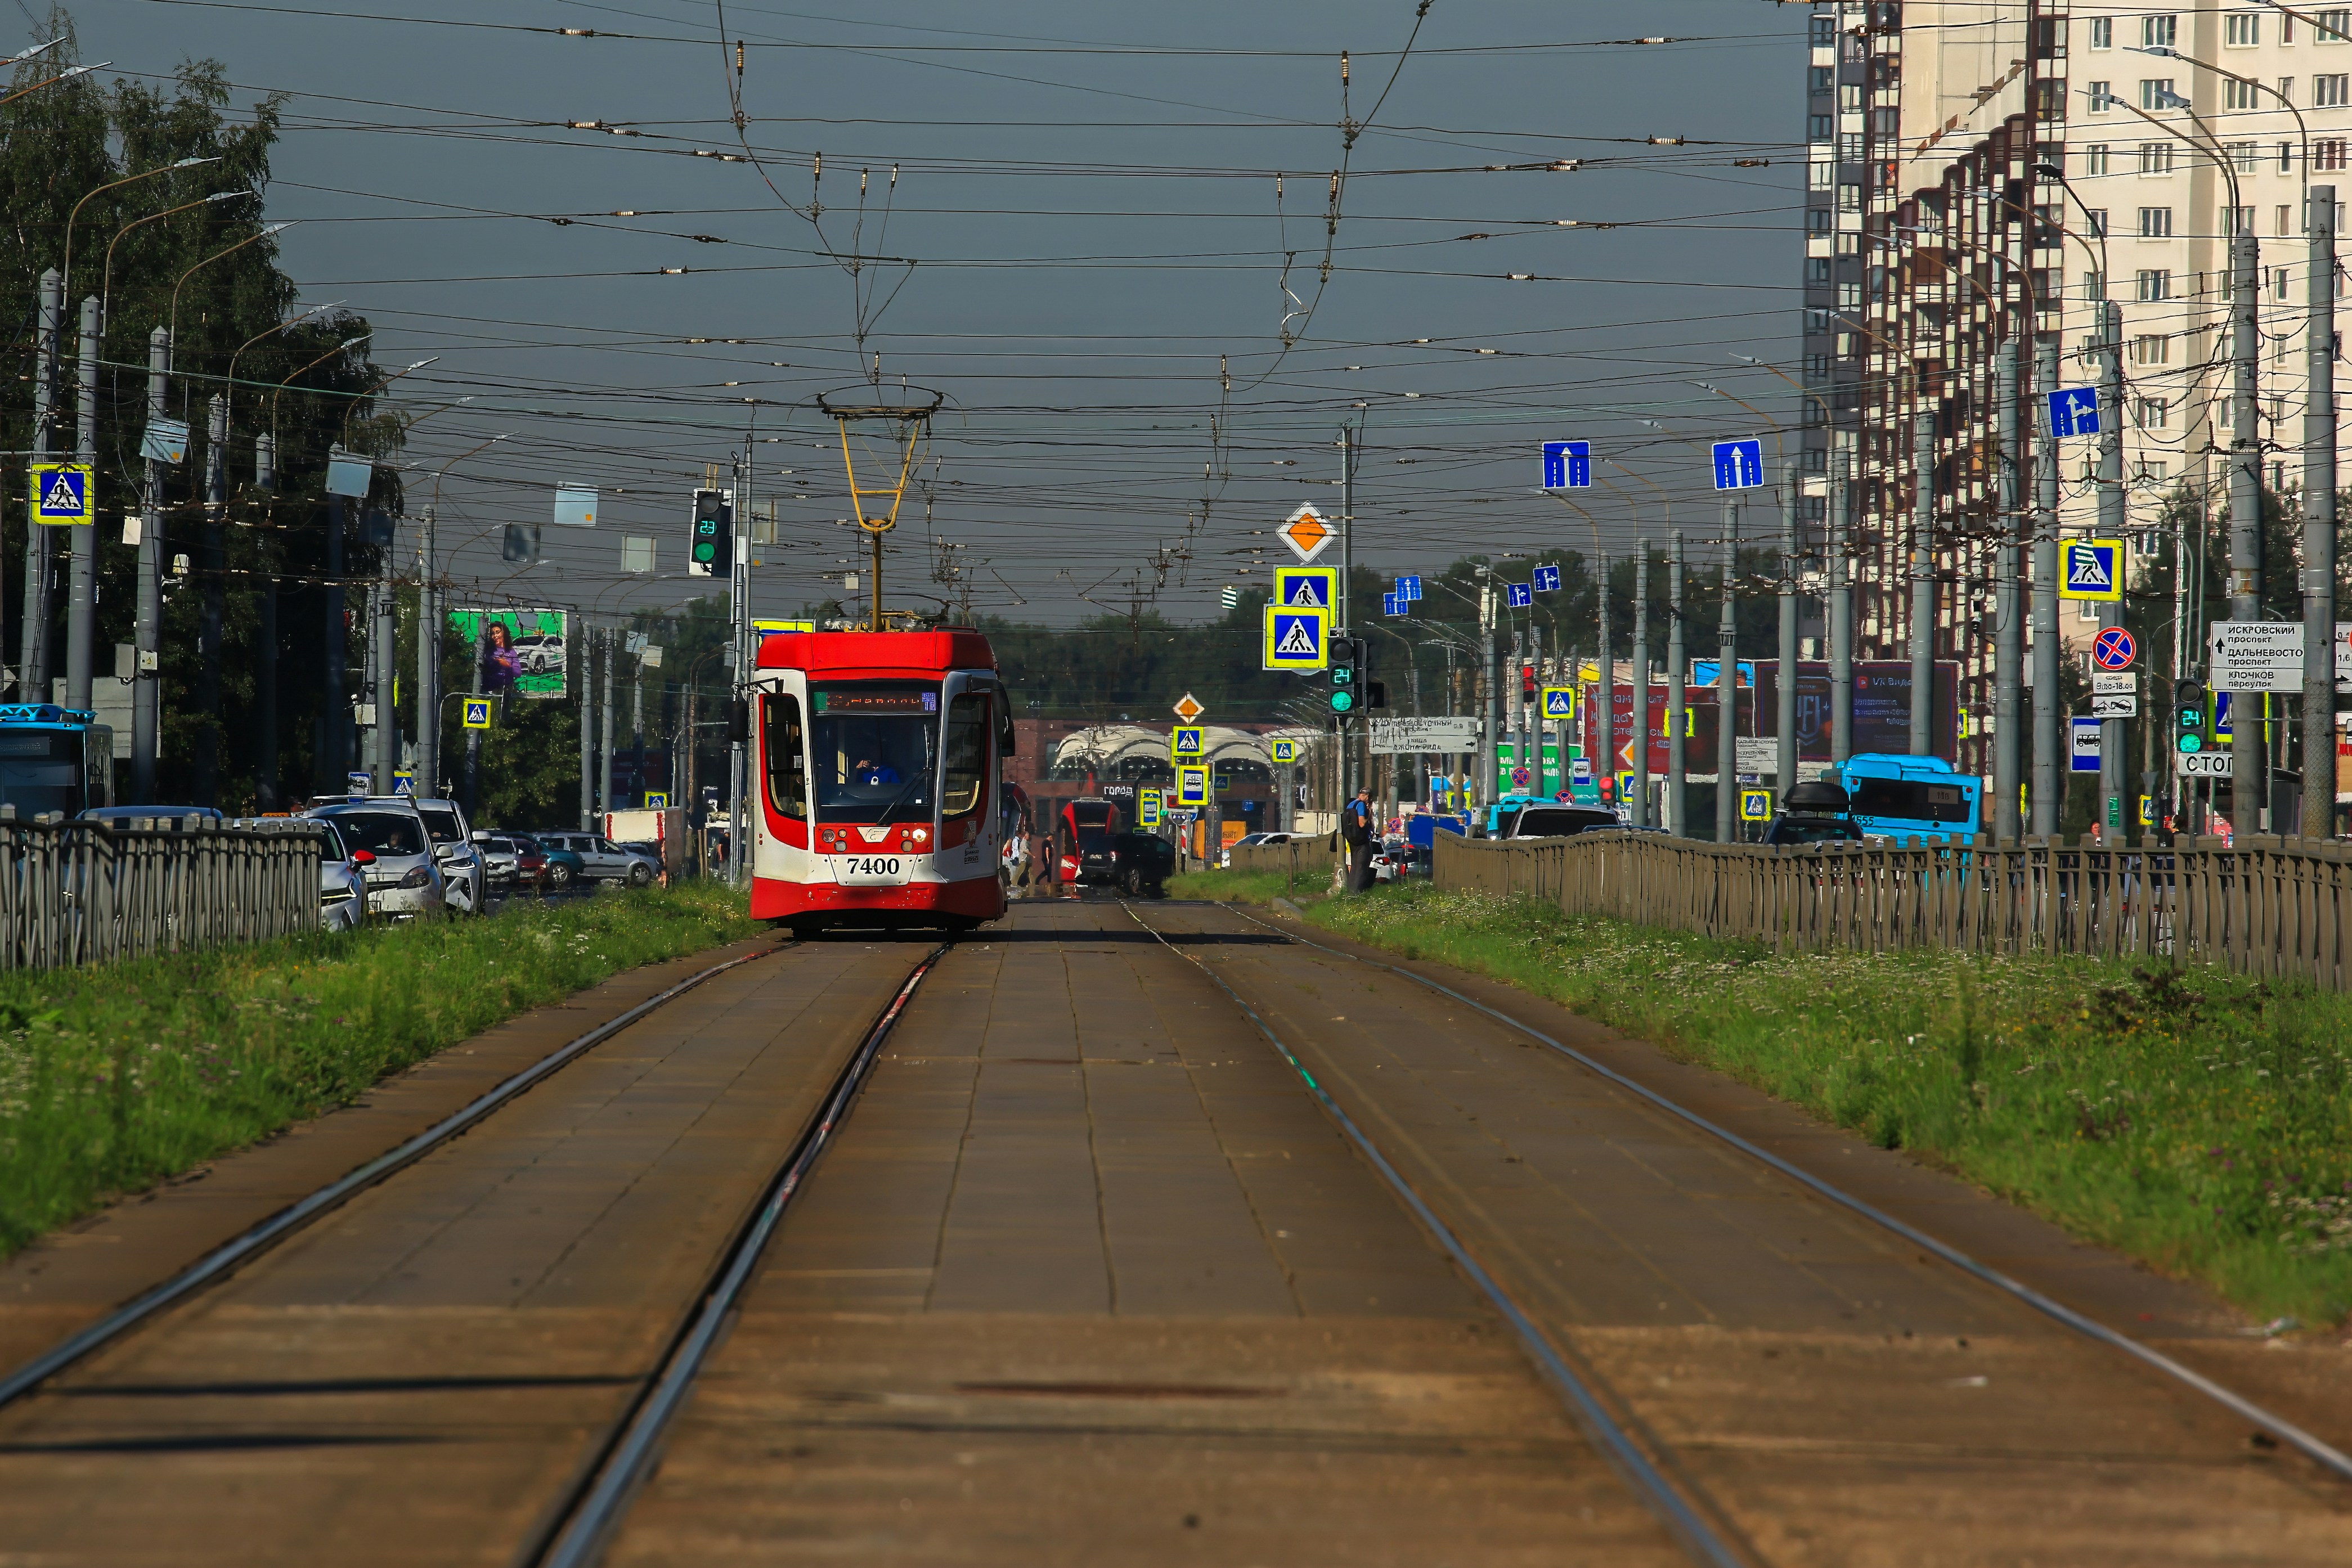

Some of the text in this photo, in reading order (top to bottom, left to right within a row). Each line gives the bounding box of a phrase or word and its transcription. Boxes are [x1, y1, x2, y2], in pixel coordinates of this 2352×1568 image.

[700, 520, 715, 534] 23
[2228, 625, 2295, 635] ИСКРОВСКИЙ
[2227, 648, 2304, 658] ДАЛЬНЕВОСТО
[1334, 669, 1349, 683] 24
[2228, 681, 2272, 690] переулок
[2182, 710, 2199, 725] 24
[847, 858, 900, 874] 7400
